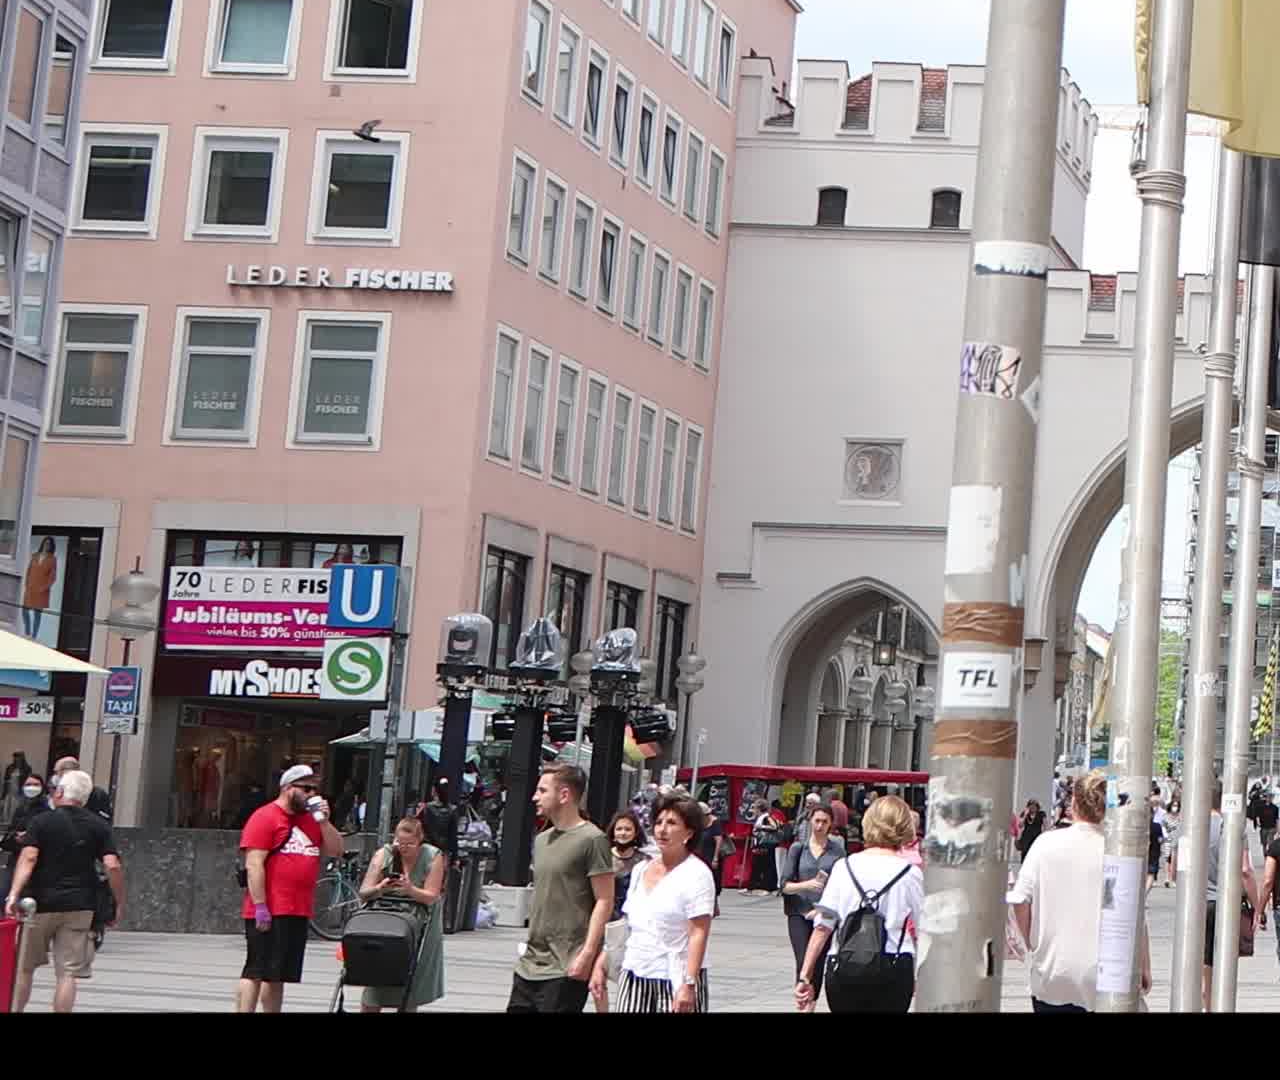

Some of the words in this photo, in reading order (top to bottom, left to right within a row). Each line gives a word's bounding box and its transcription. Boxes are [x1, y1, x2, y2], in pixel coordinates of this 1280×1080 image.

[226, 264, 333, 287] LEDER
[344, 267, 456, 291] FISCHER
[175, 571, 201, 588] 70
[208, 576, 292, 594] LEDER
[297, 578, 328, 595] FIS
[341, 568, 384, 623] U
[240, 626, 257, 638] bis
[259, 627, 291, 639] 50%
[336, 646, 372, 690] S
[957, 668, 999, 689] TFL
[106, 700, 133, 713] TAXI
